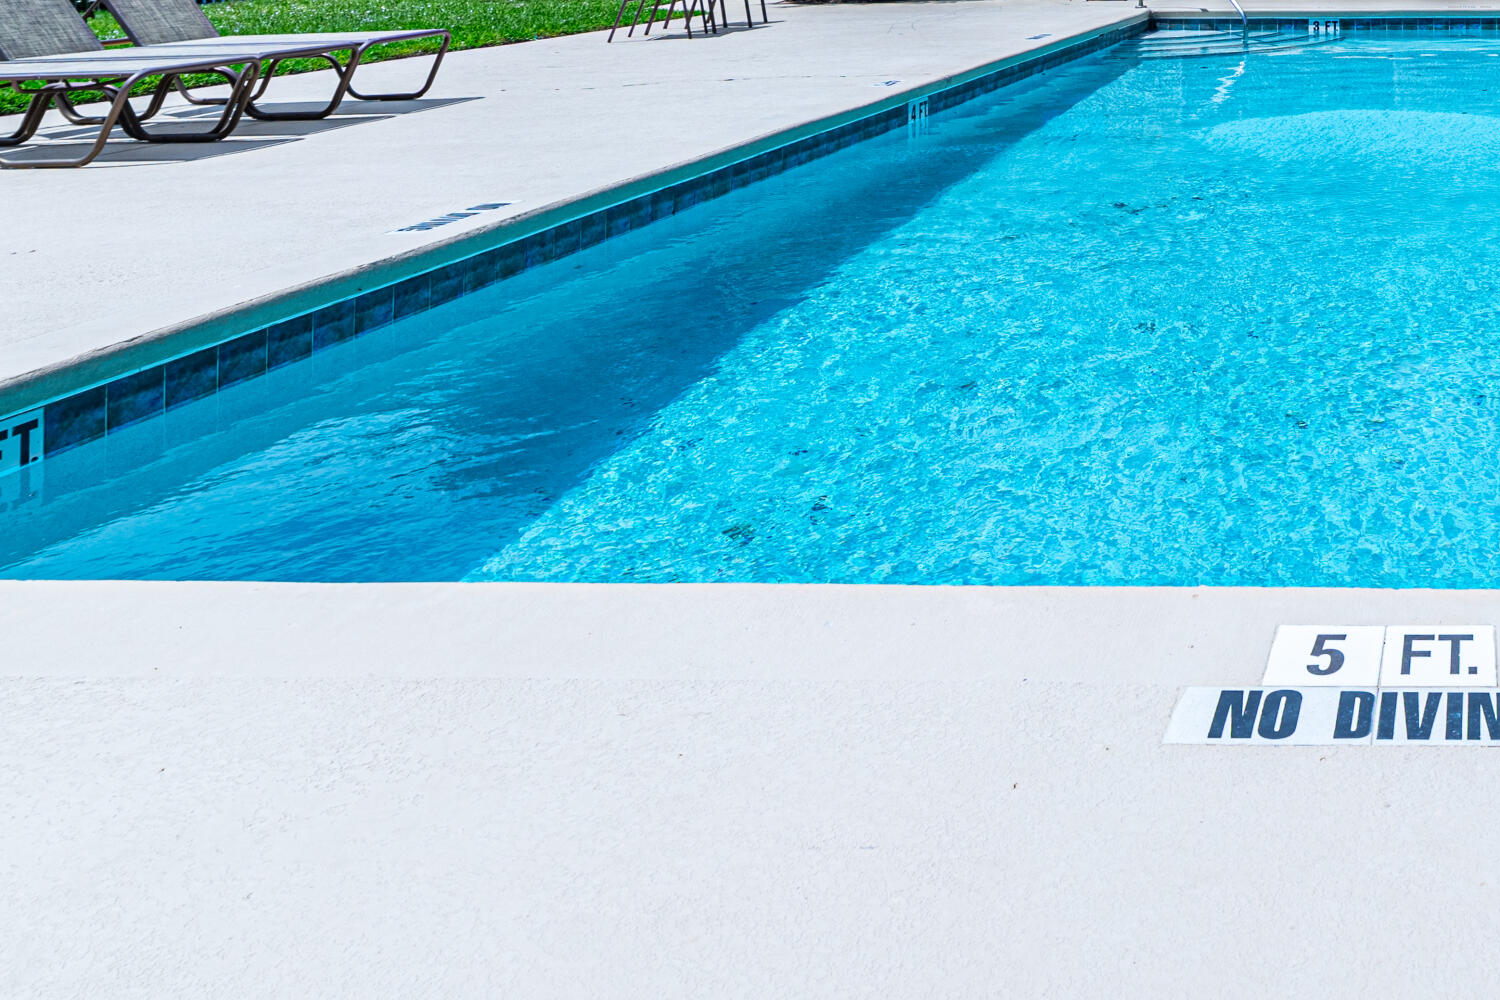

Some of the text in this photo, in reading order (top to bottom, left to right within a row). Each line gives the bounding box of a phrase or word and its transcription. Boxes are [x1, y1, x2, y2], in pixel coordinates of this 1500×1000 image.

[1306, 634, 1478, 675] 5 FT.
[1207, 689, 1303, 740] NO
